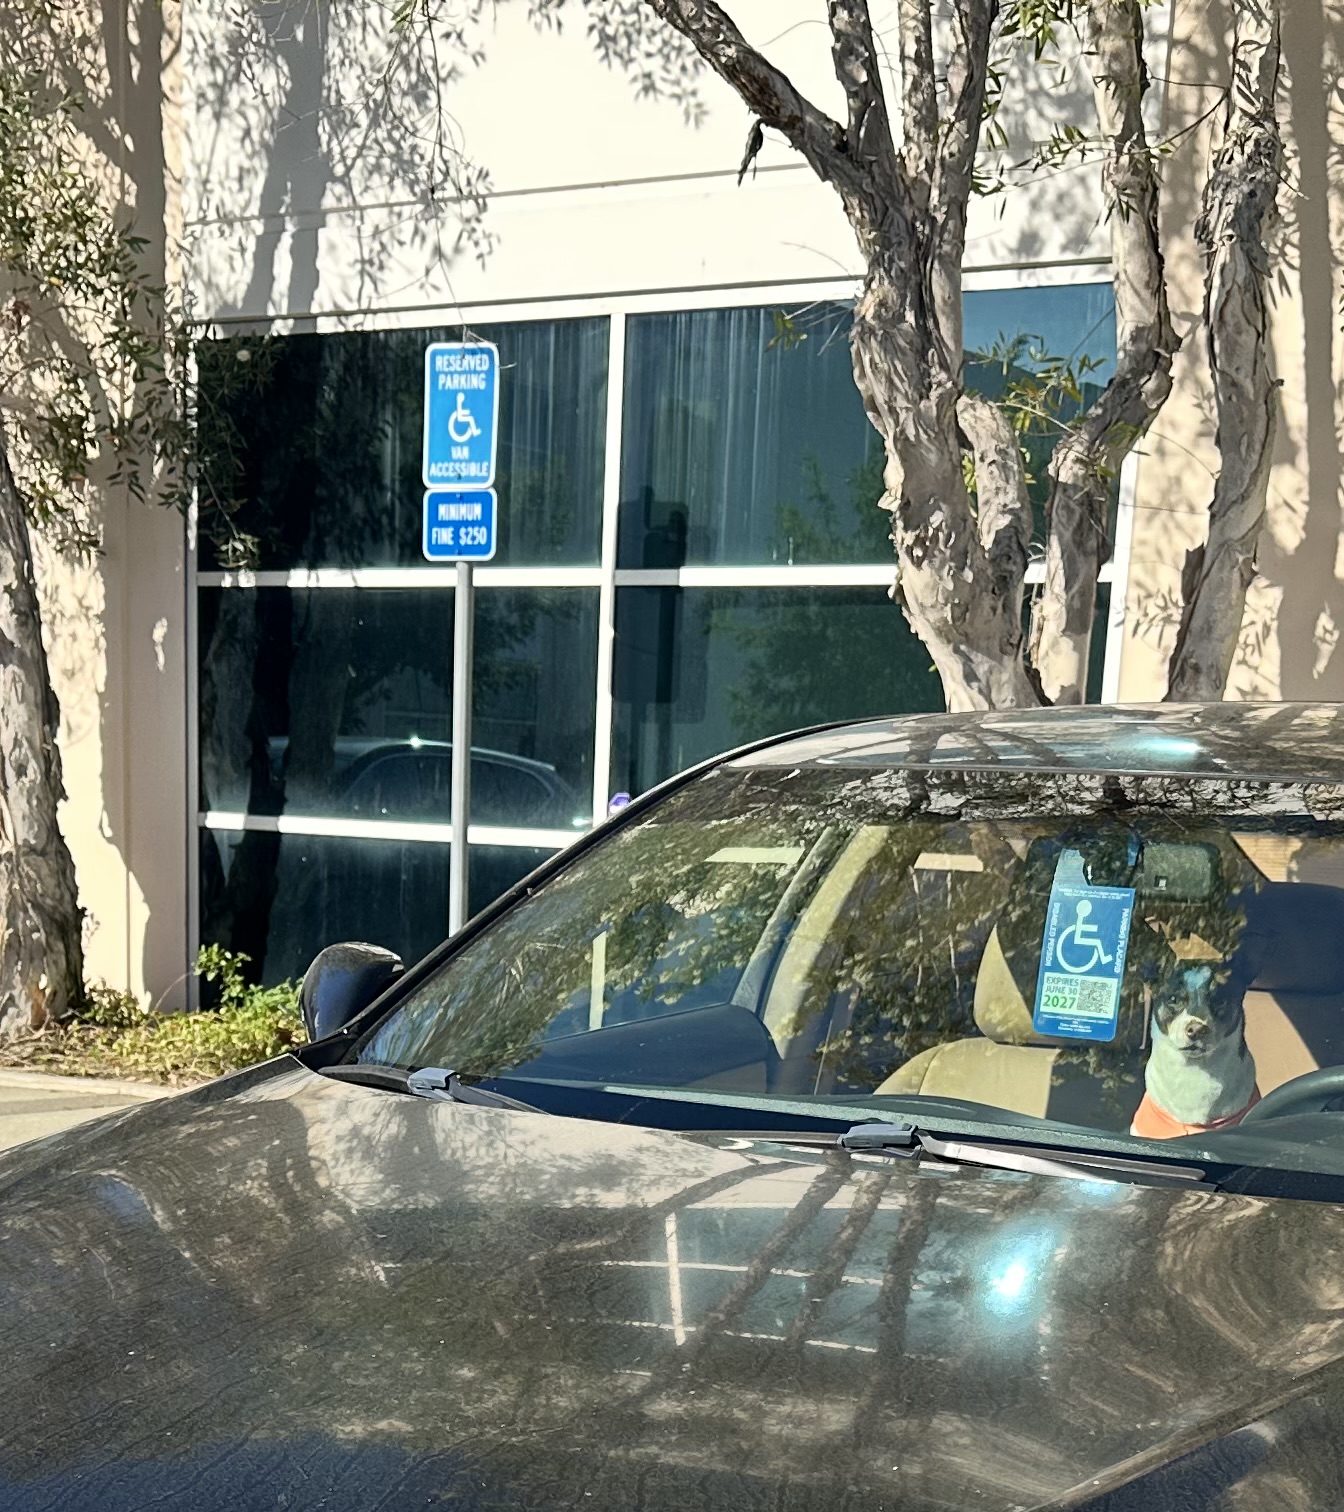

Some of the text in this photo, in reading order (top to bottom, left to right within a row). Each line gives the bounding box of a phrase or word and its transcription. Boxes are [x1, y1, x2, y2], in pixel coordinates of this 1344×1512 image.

[435, 354, 489, 371] RESERVED
[438, 373, 486, 390] PARKING
[451, 446, 469, 459] VAN
[429, 462, 489, 477] ACCESSIBLE
[438, 503, 482, 521] MINIMUM
[431, 527, 487, 545] FINE $250
[1046, 976, 1079, 987] EXPIRES
[1045, 985, 1066, 994] JUNE
[1043, 994, 1076, 1009] 2027
